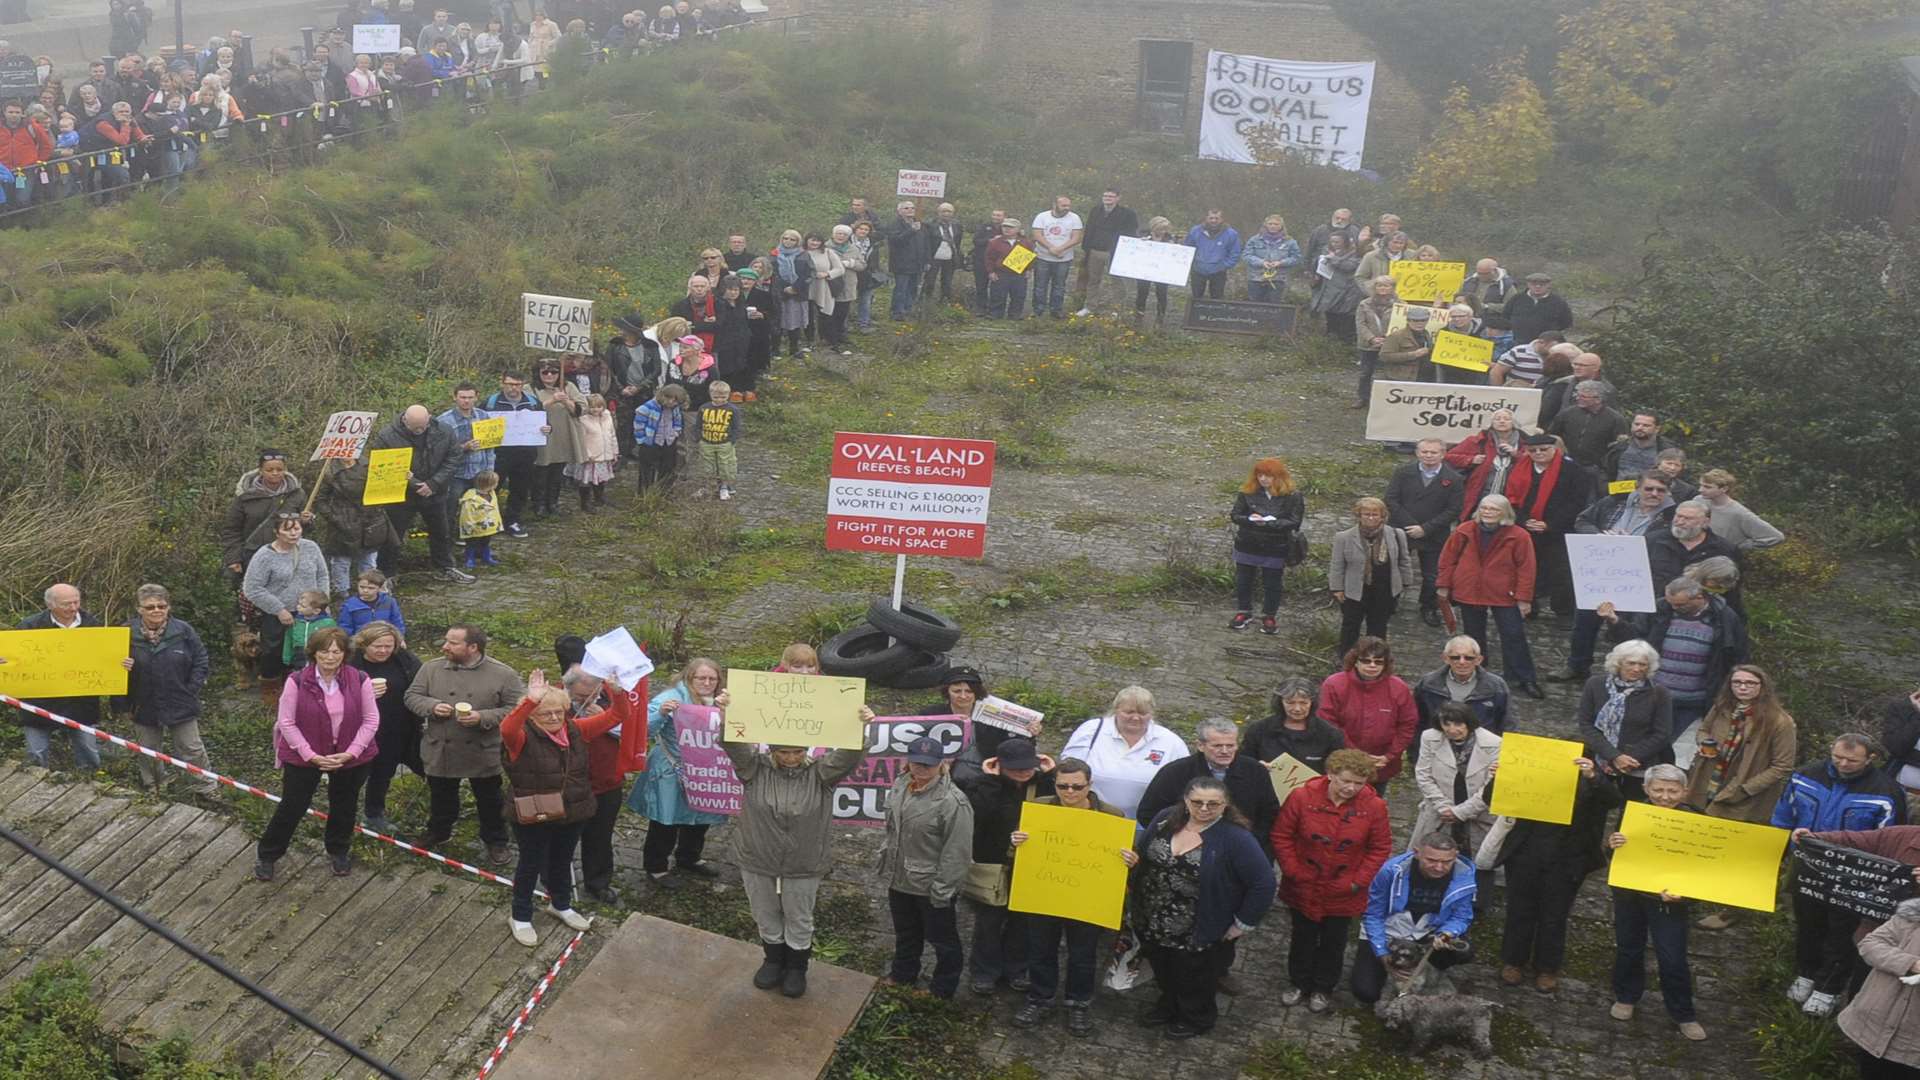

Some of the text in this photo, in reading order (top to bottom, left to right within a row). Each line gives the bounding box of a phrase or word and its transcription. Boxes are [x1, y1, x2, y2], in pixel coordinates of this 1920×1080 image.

[1210, 54, 1312, 95] follow
[528, 301, 591, 325] RETURN
[545, 321, 570, 335] TO
[525, 331, 591, 353] TENDER
[842, 443, 984, 466] OVAL LAND
[857, 462, 966, 479] (REEVES BEACH)
[835, 486, 984, 503] CCC SELLING £160,000?
[837, 499, 981, 515] WORTH £1 MILLION+?
[837, 521, 975, 539] FIGHT IT FOR MORE
[861, 535, 948, 549] OPEN SPACE
[21, 640, 65, 654] SAVE
[2, 671, 57, 682] PUBLIC
[753, 674, 816, 700] Right
[757, 708, 824, 735] Wrong
[686, 764, 728, 779] Trade
[1824, 849, 1846, 860] OH
[1820, 872, 1841, 882] THE
[1836, 864, 1888, 882] STUMPED
[1892, 878, 1910, 886] AT
[1800, 887, 1824, 900] SAVE
[1829, 898, 1852, 909] OUR
